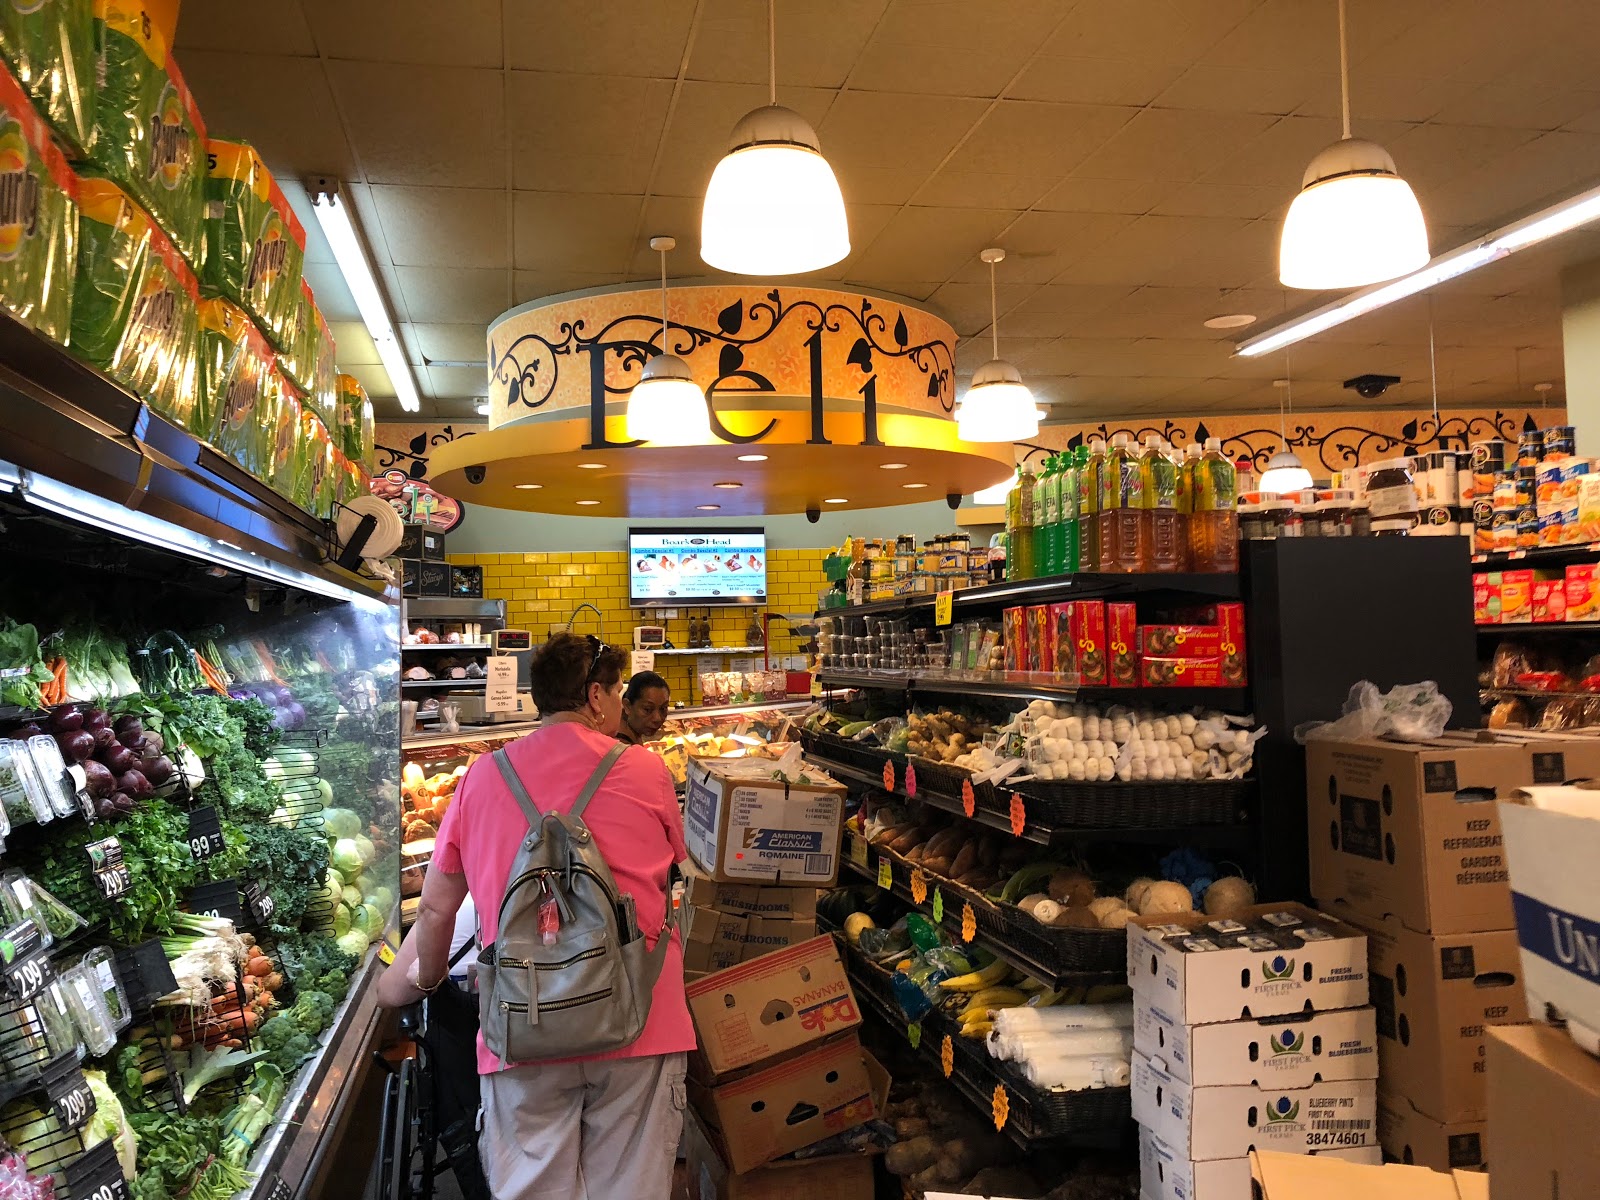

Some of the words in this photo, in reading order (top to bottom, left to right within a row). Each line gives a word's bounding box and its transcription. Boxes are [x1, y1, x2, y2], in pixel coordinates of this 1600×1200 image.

[576, 327, 885, 449] Deli
[421, 570, 444, 586] Stacy's
[1466, 819, 1491, 832] KEEP
[771, 832, 812, 840] AMERICAN
[768, 838, 813, 849] Classic
[1443, 835, 1502, 850] REFRIGERAT
[759, 851, 805, 860] ROMAINE
[1461, 855, 1502, 869] GARDER
[721, 898, 790, 912] MUSHROOMS
[722, 931, 789, 945] MUSHROOMS
[1330, 966, 1352, 975] FRESH
[1319, 973, 1364, 984] BLUEBERRIES
[1254, 984, 1279, 993] FIRST
[1281, 981, 1302, 990] PICK
[793, 980, 846, 1007] BANANAS
[800, 997, 857, 1032] Dole
[1484, 1006, 1509, 1018] KEEP
[1340, 1040, 1361, 1048] FRESH
[1328, 1046, 1373, 1058] BLUEBERRIES
[1263, 1058, 1288, 1067] FIRST
[1290, 1056, 1312, 1064] PICK
[1309, 1098, 1337, 1108] BLUEBERRY
[1338, 1098, 1354, 1108] PINTS
[1308, 1110, 1323, 1118] FIRST
[1323, 1110, 1335, 1118] PICK
[1258, 1125, 1283, 1134] FIRST
[1284, 1123, 1306, 1132] PICK
[1306, 1132, 1366, 1145] 38474601
